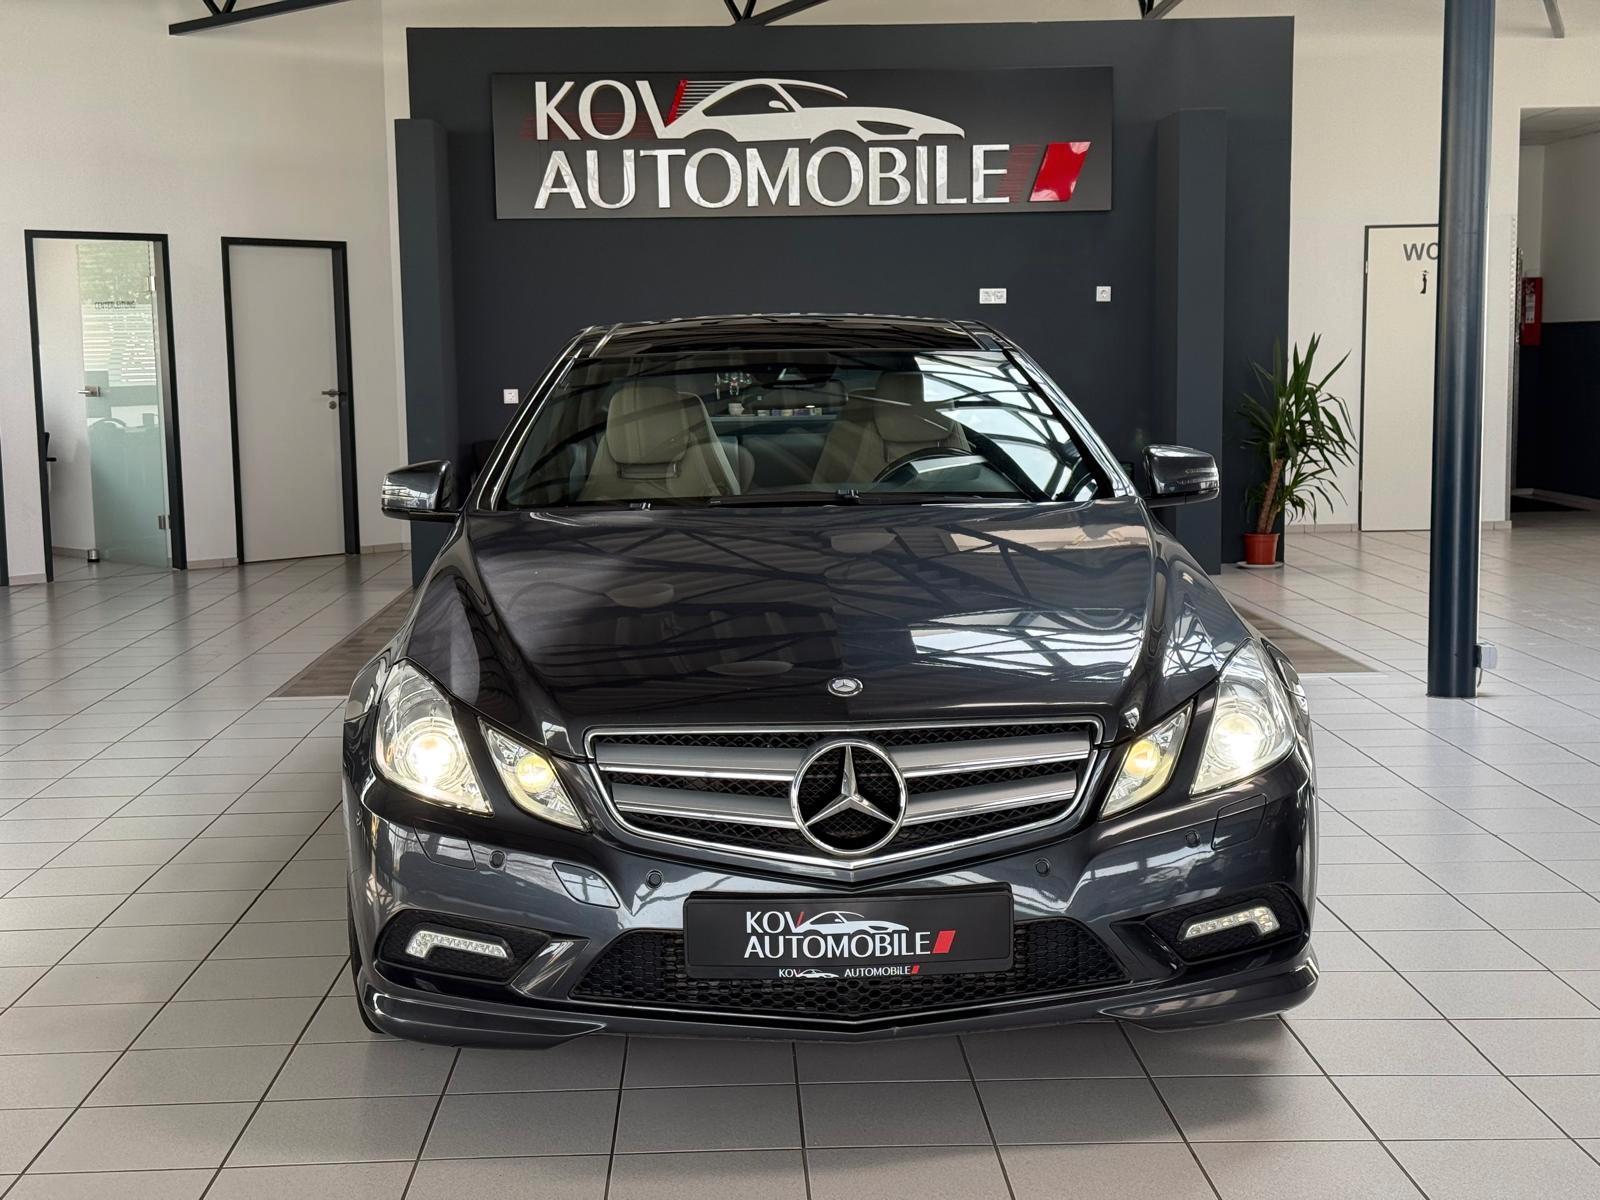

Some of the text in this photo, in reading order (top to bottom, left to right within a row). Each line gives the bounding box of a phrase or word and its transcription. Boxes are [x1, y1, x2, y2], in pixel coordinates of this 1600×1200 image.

[535, 80, 687, 141] KOV
[534, 144, 1010, 209] AUTOMOBILE
[746, 911, 804, 934] KOV
[744, 931, 931, 959] AUTOMOBILE
[778, 968, 801, 978] KOV
